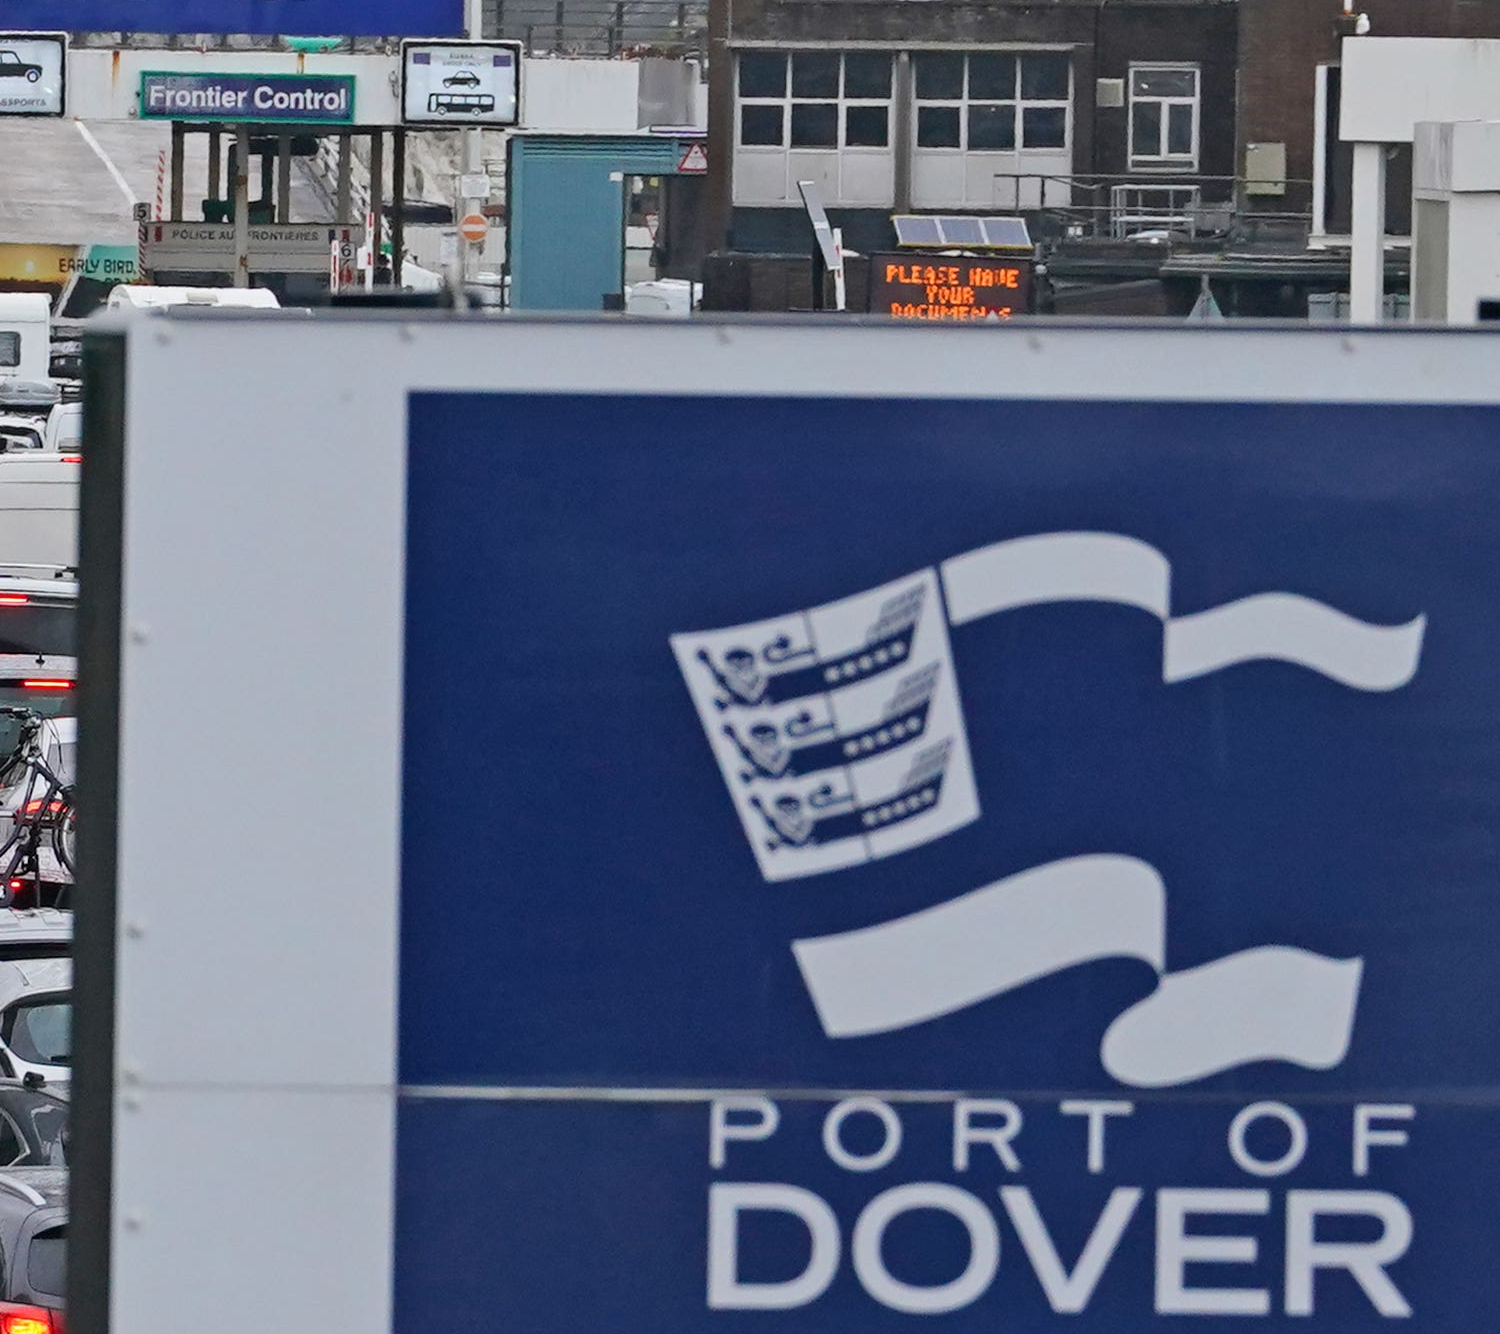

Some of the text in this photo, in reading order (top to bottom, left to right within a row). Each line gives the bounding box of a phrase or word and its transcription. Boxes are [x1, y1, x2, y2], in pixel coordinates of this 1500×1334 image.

[148, 85, 347, 110] Frontier Control
[137, 205, 147, 219] 5
[172, 229, 215, 240] POLICE
[341, 243, 352, 258] 6
[59, 259, 100, 275] EARLY
[886, 264, 959, 284] PLEASE
[926, 286, 975, 304] YOUR
[889, 303, 1012, 323] DOCUMENS
[710, 1098, 1415, 1175] PORT OF
[708, 1183, 1413, 1318] DOVER
